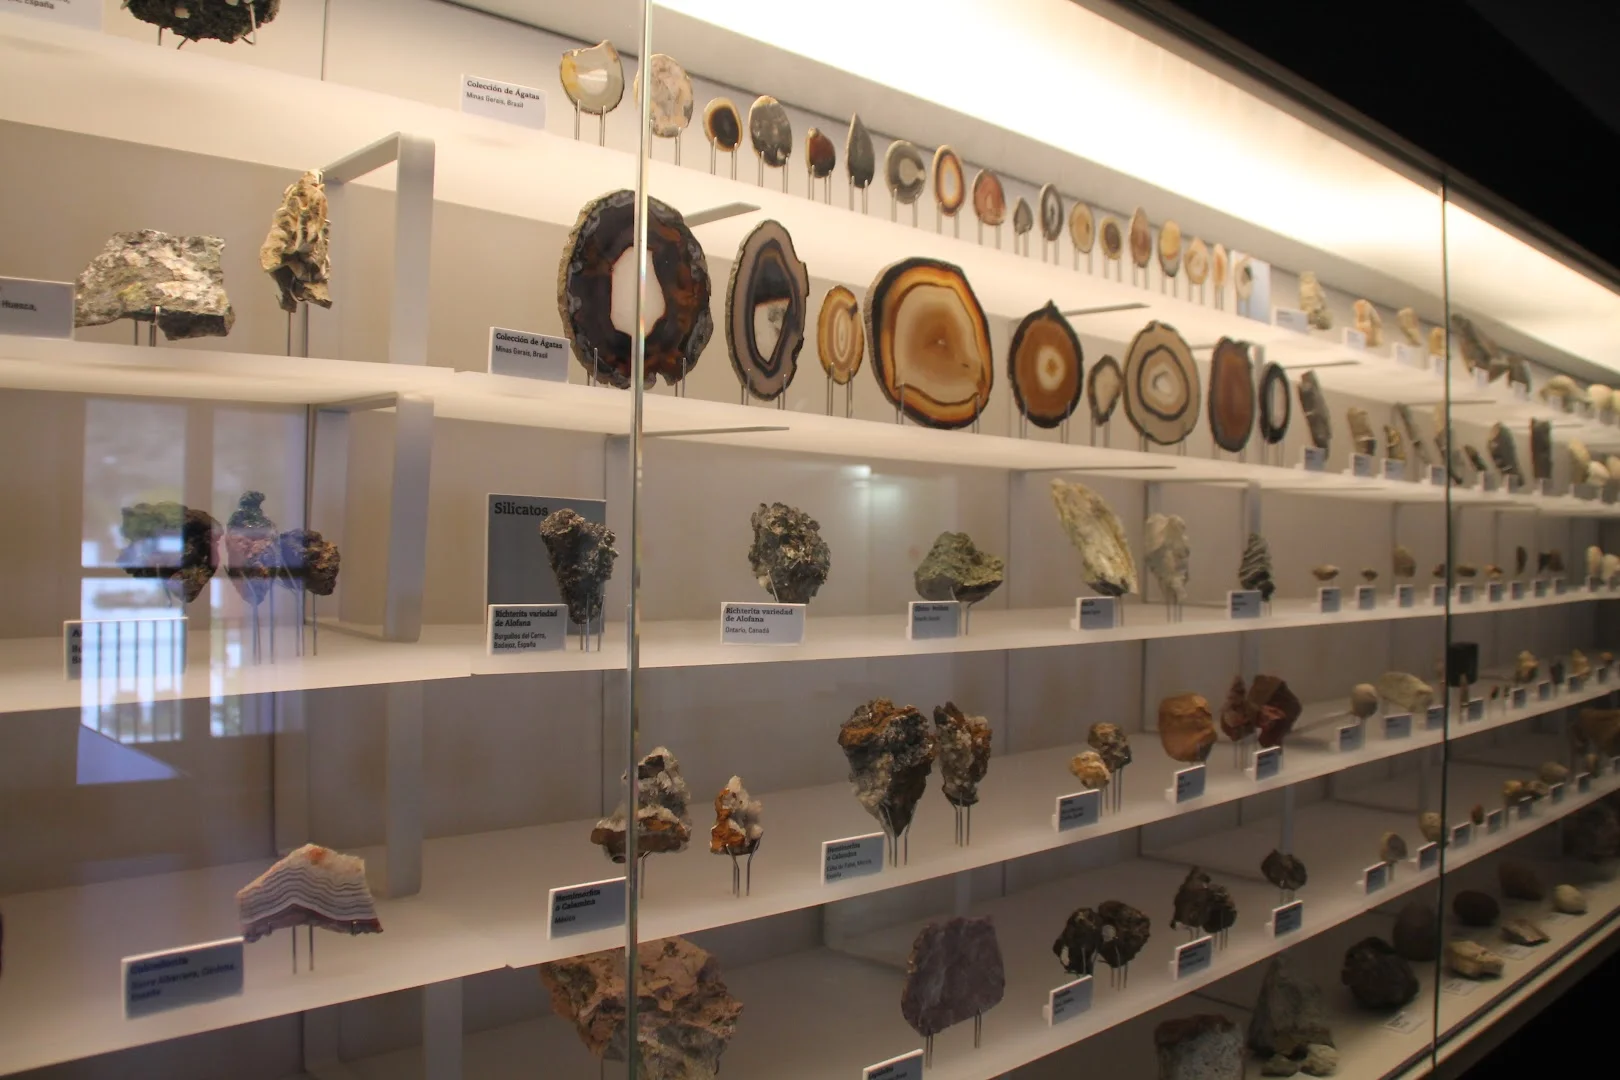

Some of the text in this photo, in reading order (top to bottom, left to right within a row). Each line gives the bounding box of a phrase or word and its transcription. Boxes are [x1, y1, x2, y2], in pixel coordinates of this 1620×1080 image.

[467, 80, 540, 100] Colección de Ágatas
[466, 91, 524, 108] Minas Gerais, Brasil
[496, 332, 563, 349] Colección de Ágatas
[495, 345, 548, 359] Minas Gerais, Brasil
[494, 502, 549, 517] Silicatos
[725, 607, 793, 616] Richterita variedad
[494, 619, 532, 627] de Alofana
[725, 626, 747, 634] Ontario,
